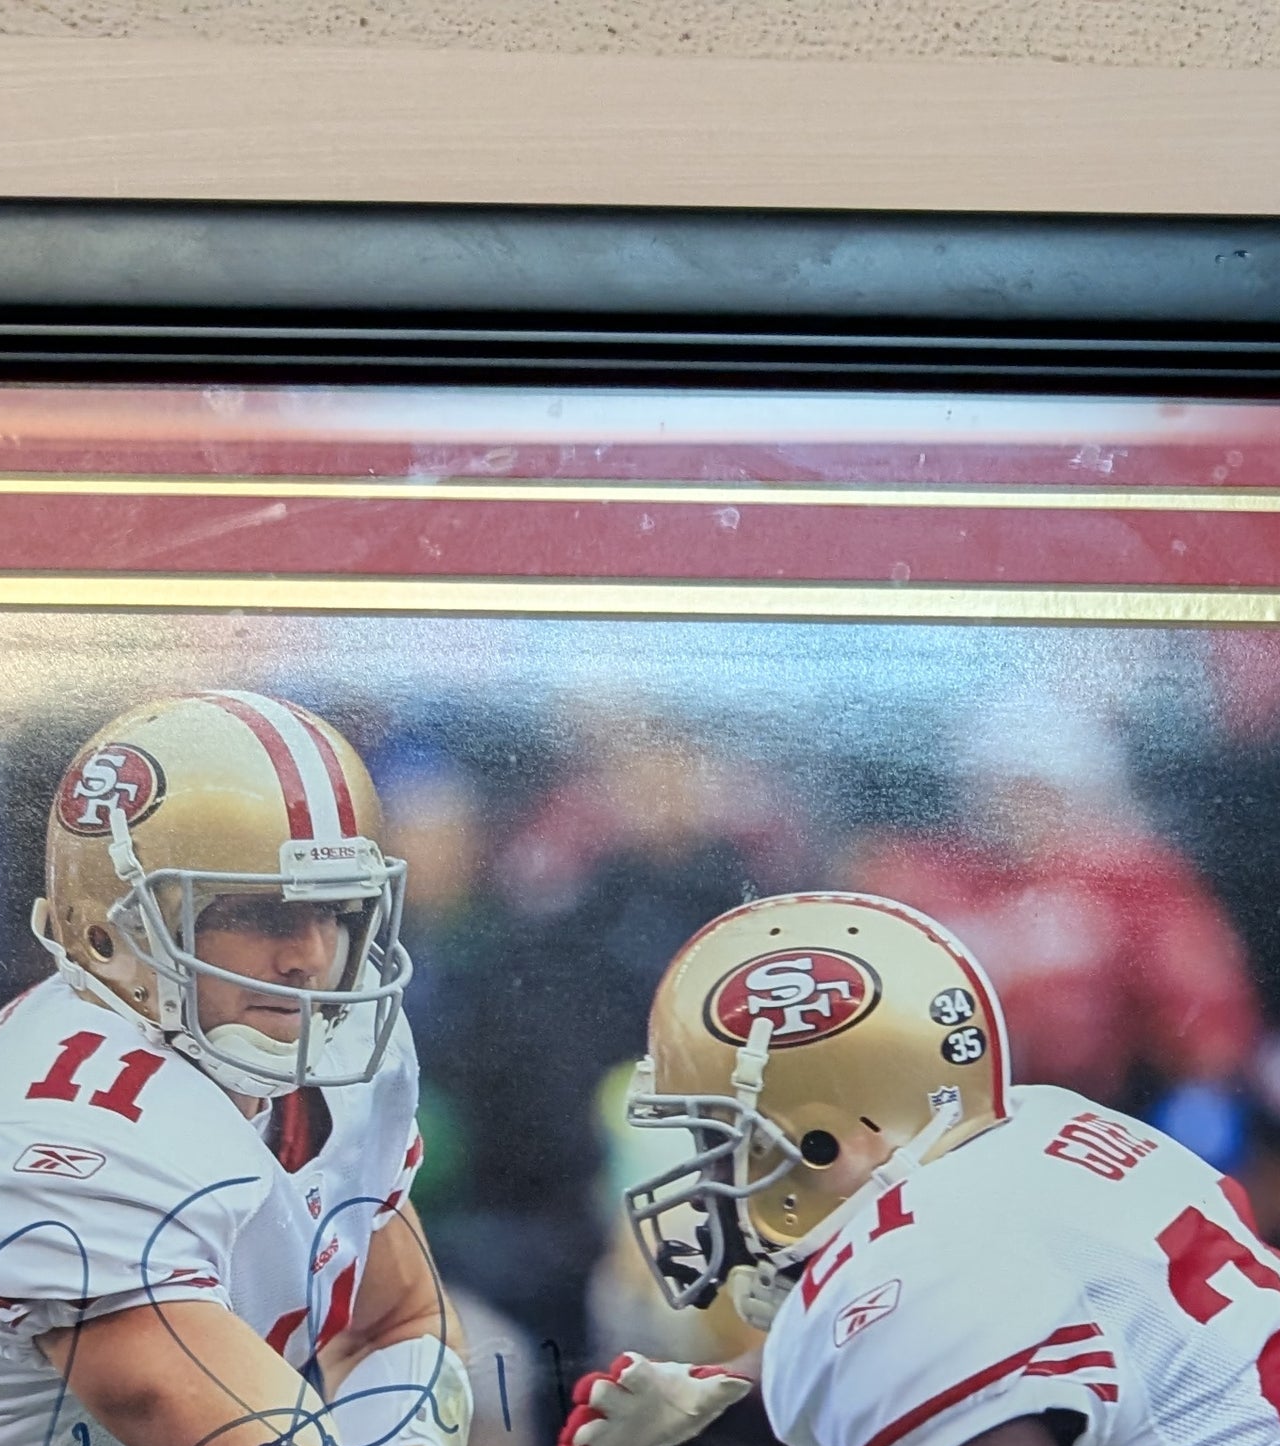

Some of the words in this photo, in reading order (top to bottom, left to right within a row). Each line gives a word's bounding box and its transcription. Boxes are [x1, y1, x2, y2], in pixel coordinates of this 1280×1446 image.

[934, 989, 973, 1024] 34
[948, 1028, 982, 1062] 35
[25, 1031, 166, 1123] 11
[1044, 1112, 1158, 1181] GOR
